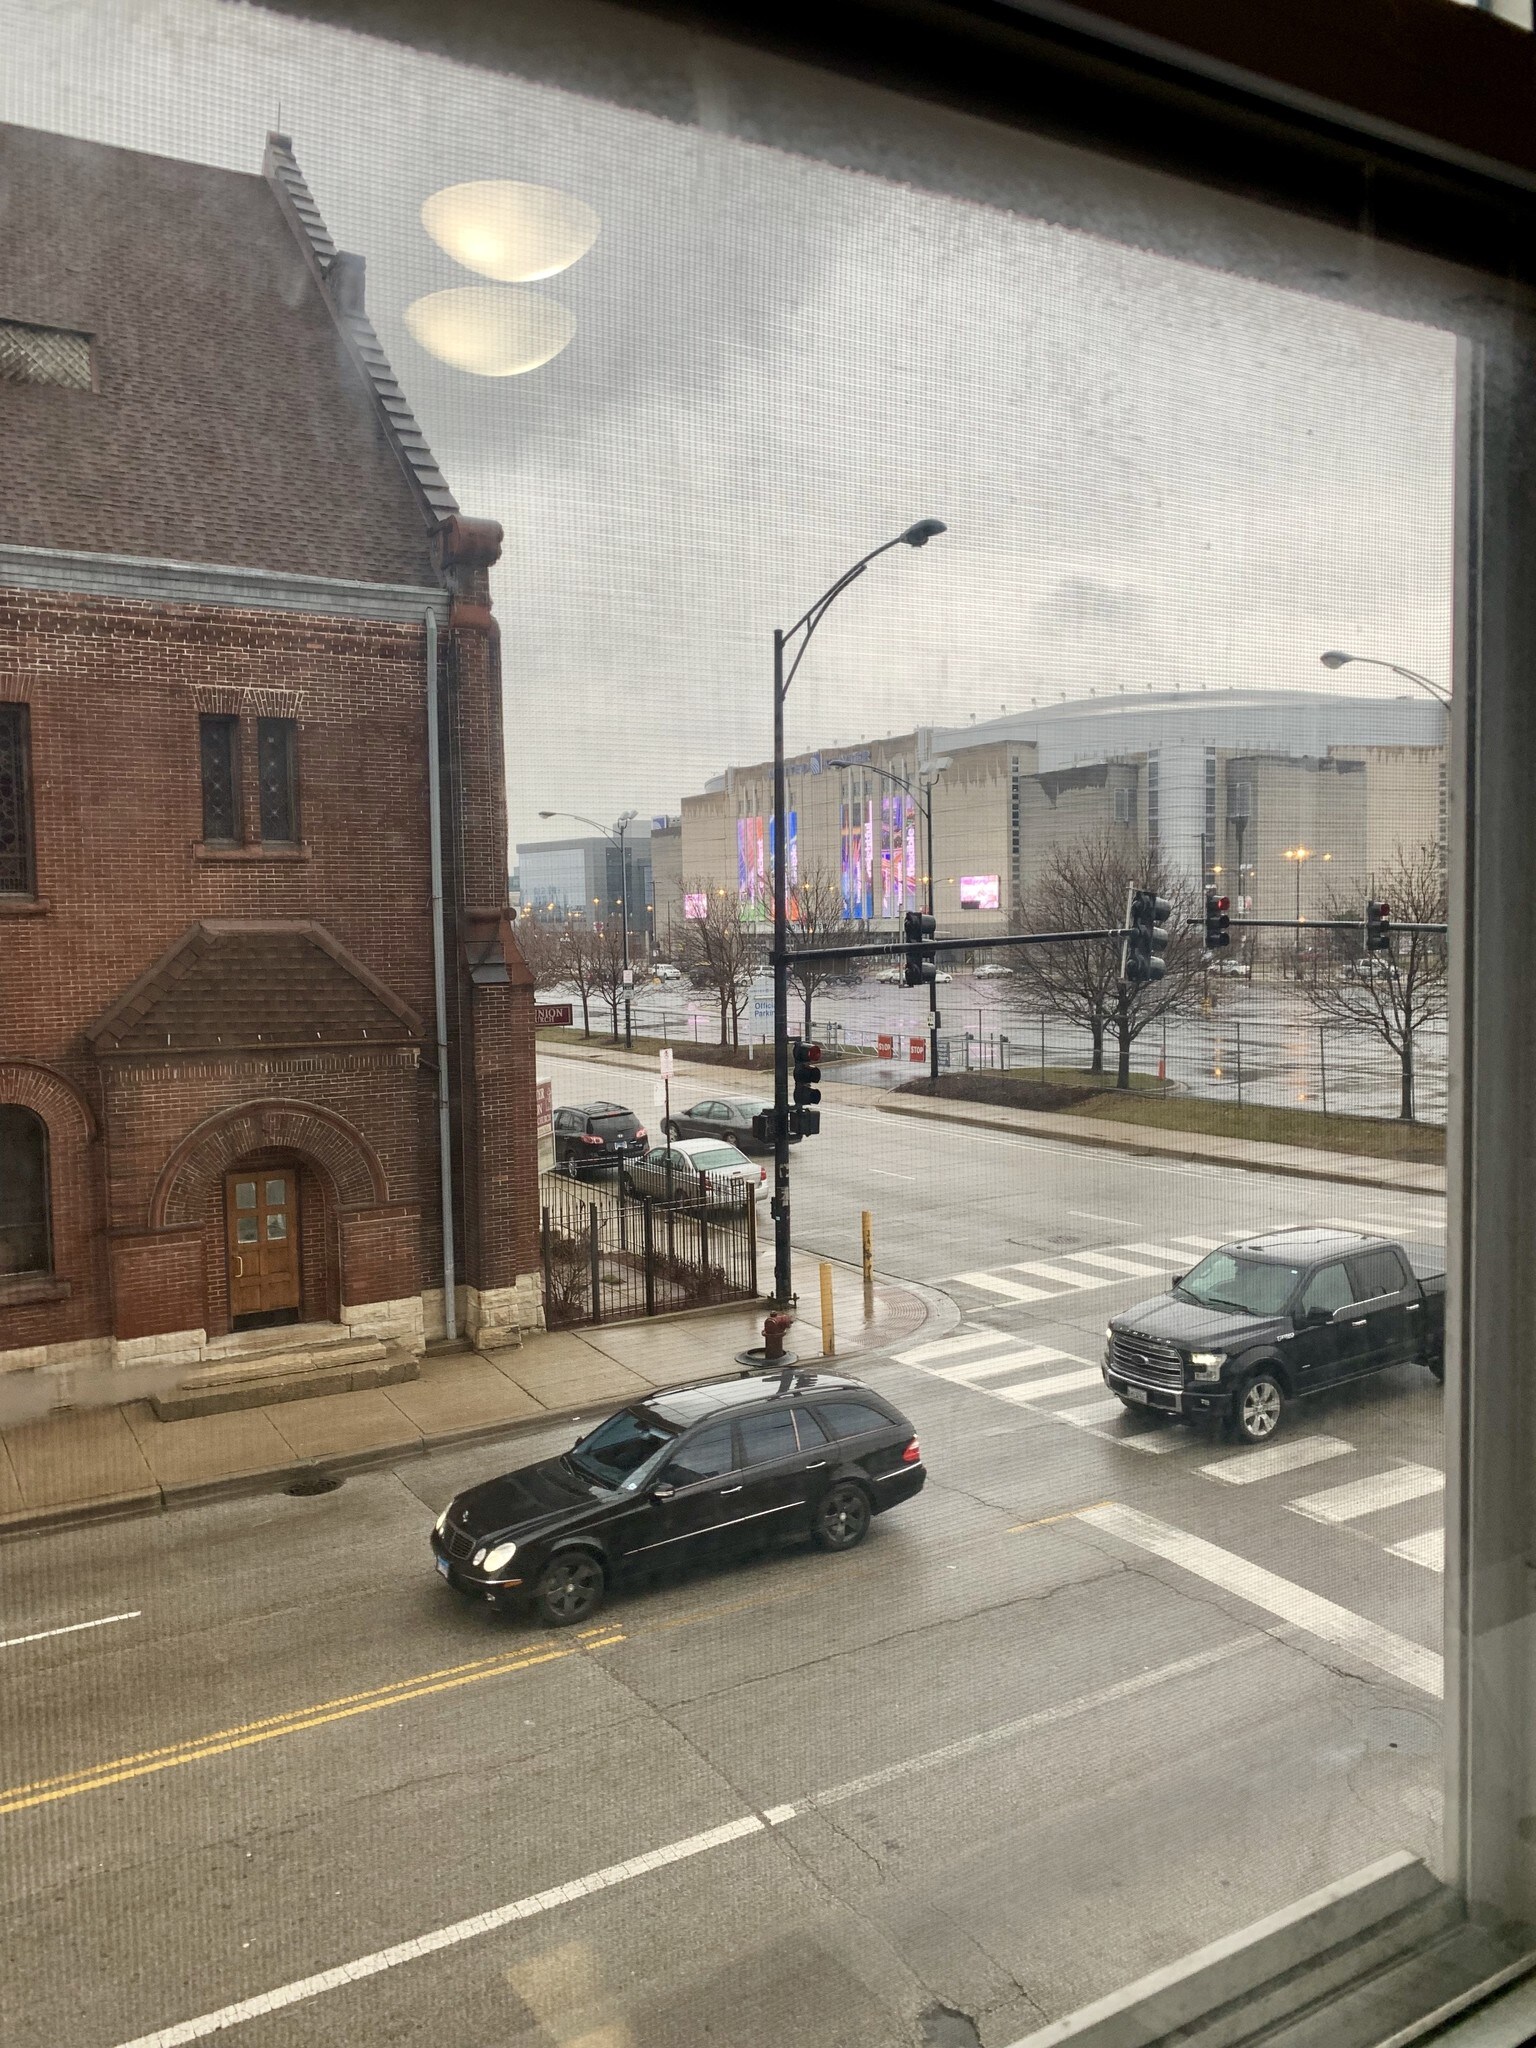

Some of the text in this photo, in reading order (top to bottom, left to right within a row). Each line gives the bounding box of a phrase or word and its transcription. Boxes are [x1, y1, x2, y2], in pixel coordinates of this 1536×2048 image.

[755, 1002, 774, 1010] Offici
[755, 1010, 775, 1018] Parkin
[879, 1043, 891, 1051] STOP
[911, 1046, 924, 1054] STOP
